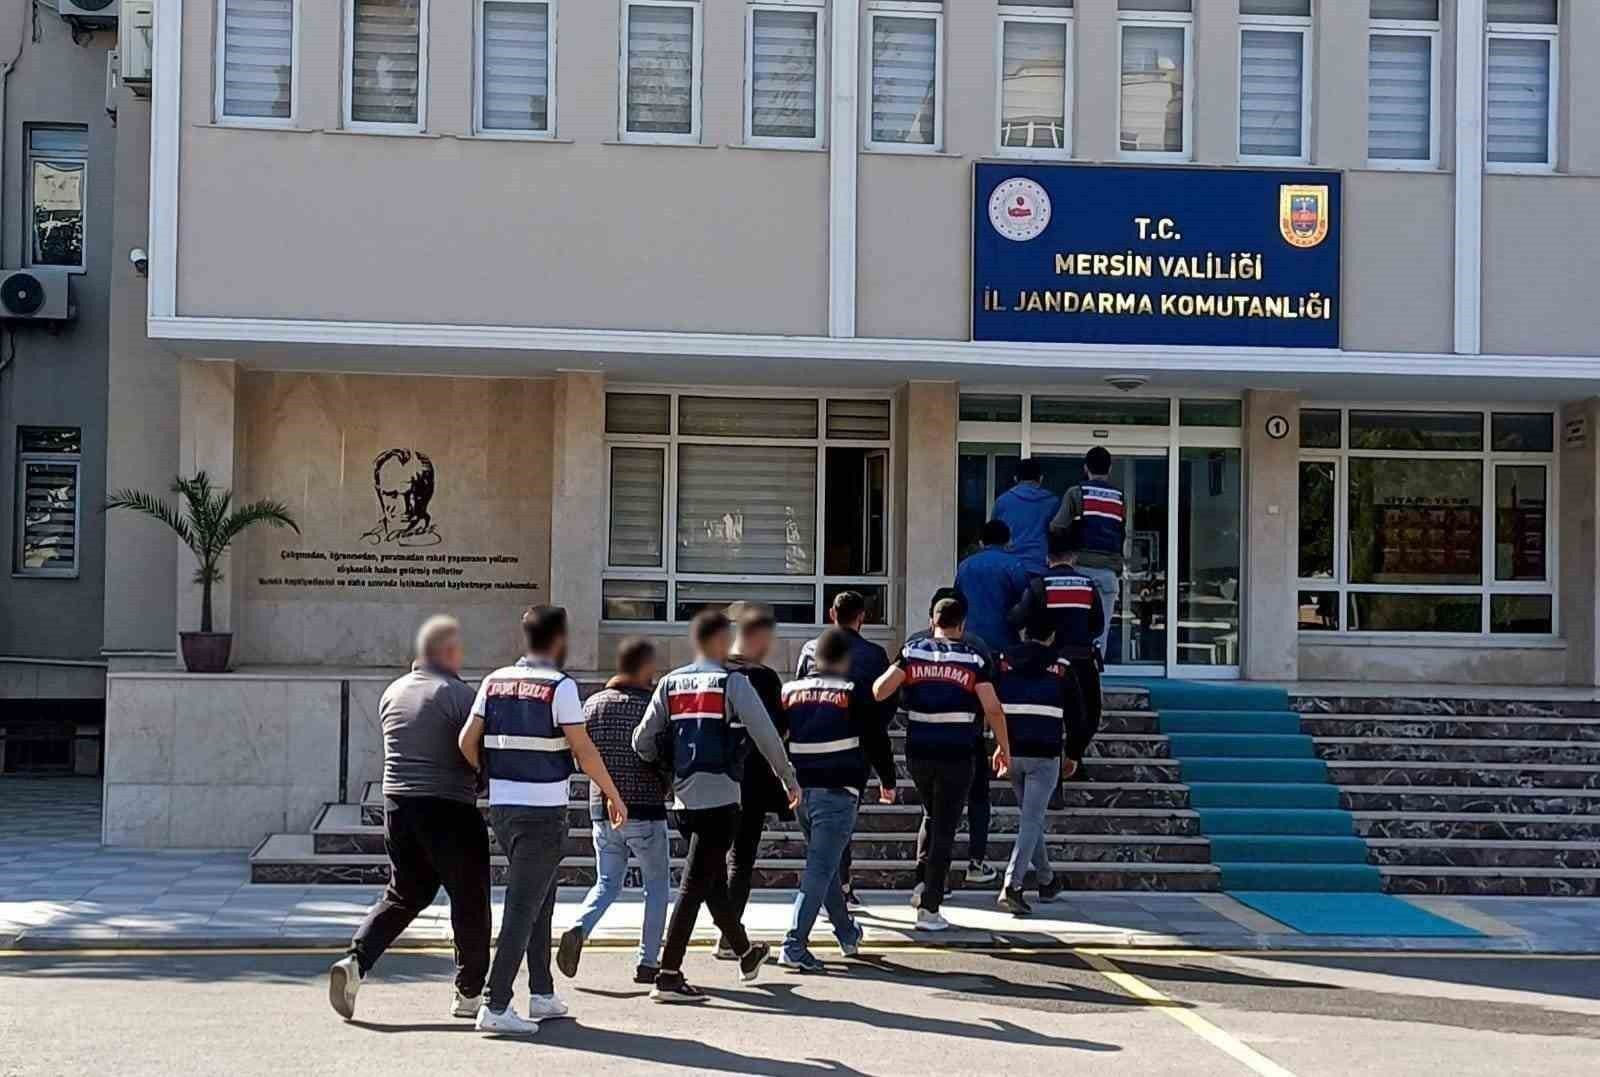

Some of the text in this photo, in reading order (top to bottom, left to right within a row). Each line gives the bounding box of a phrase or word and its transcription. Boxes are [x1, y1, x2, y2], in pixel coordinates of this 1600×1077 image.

[1134, 217, 1181, 241] T.C.
[1055, 250, 1262, 280] MERSİN VALİLİĞİ
[984, 285, 1331, 320] İL JANDARMA KOMUTANLIĞI
